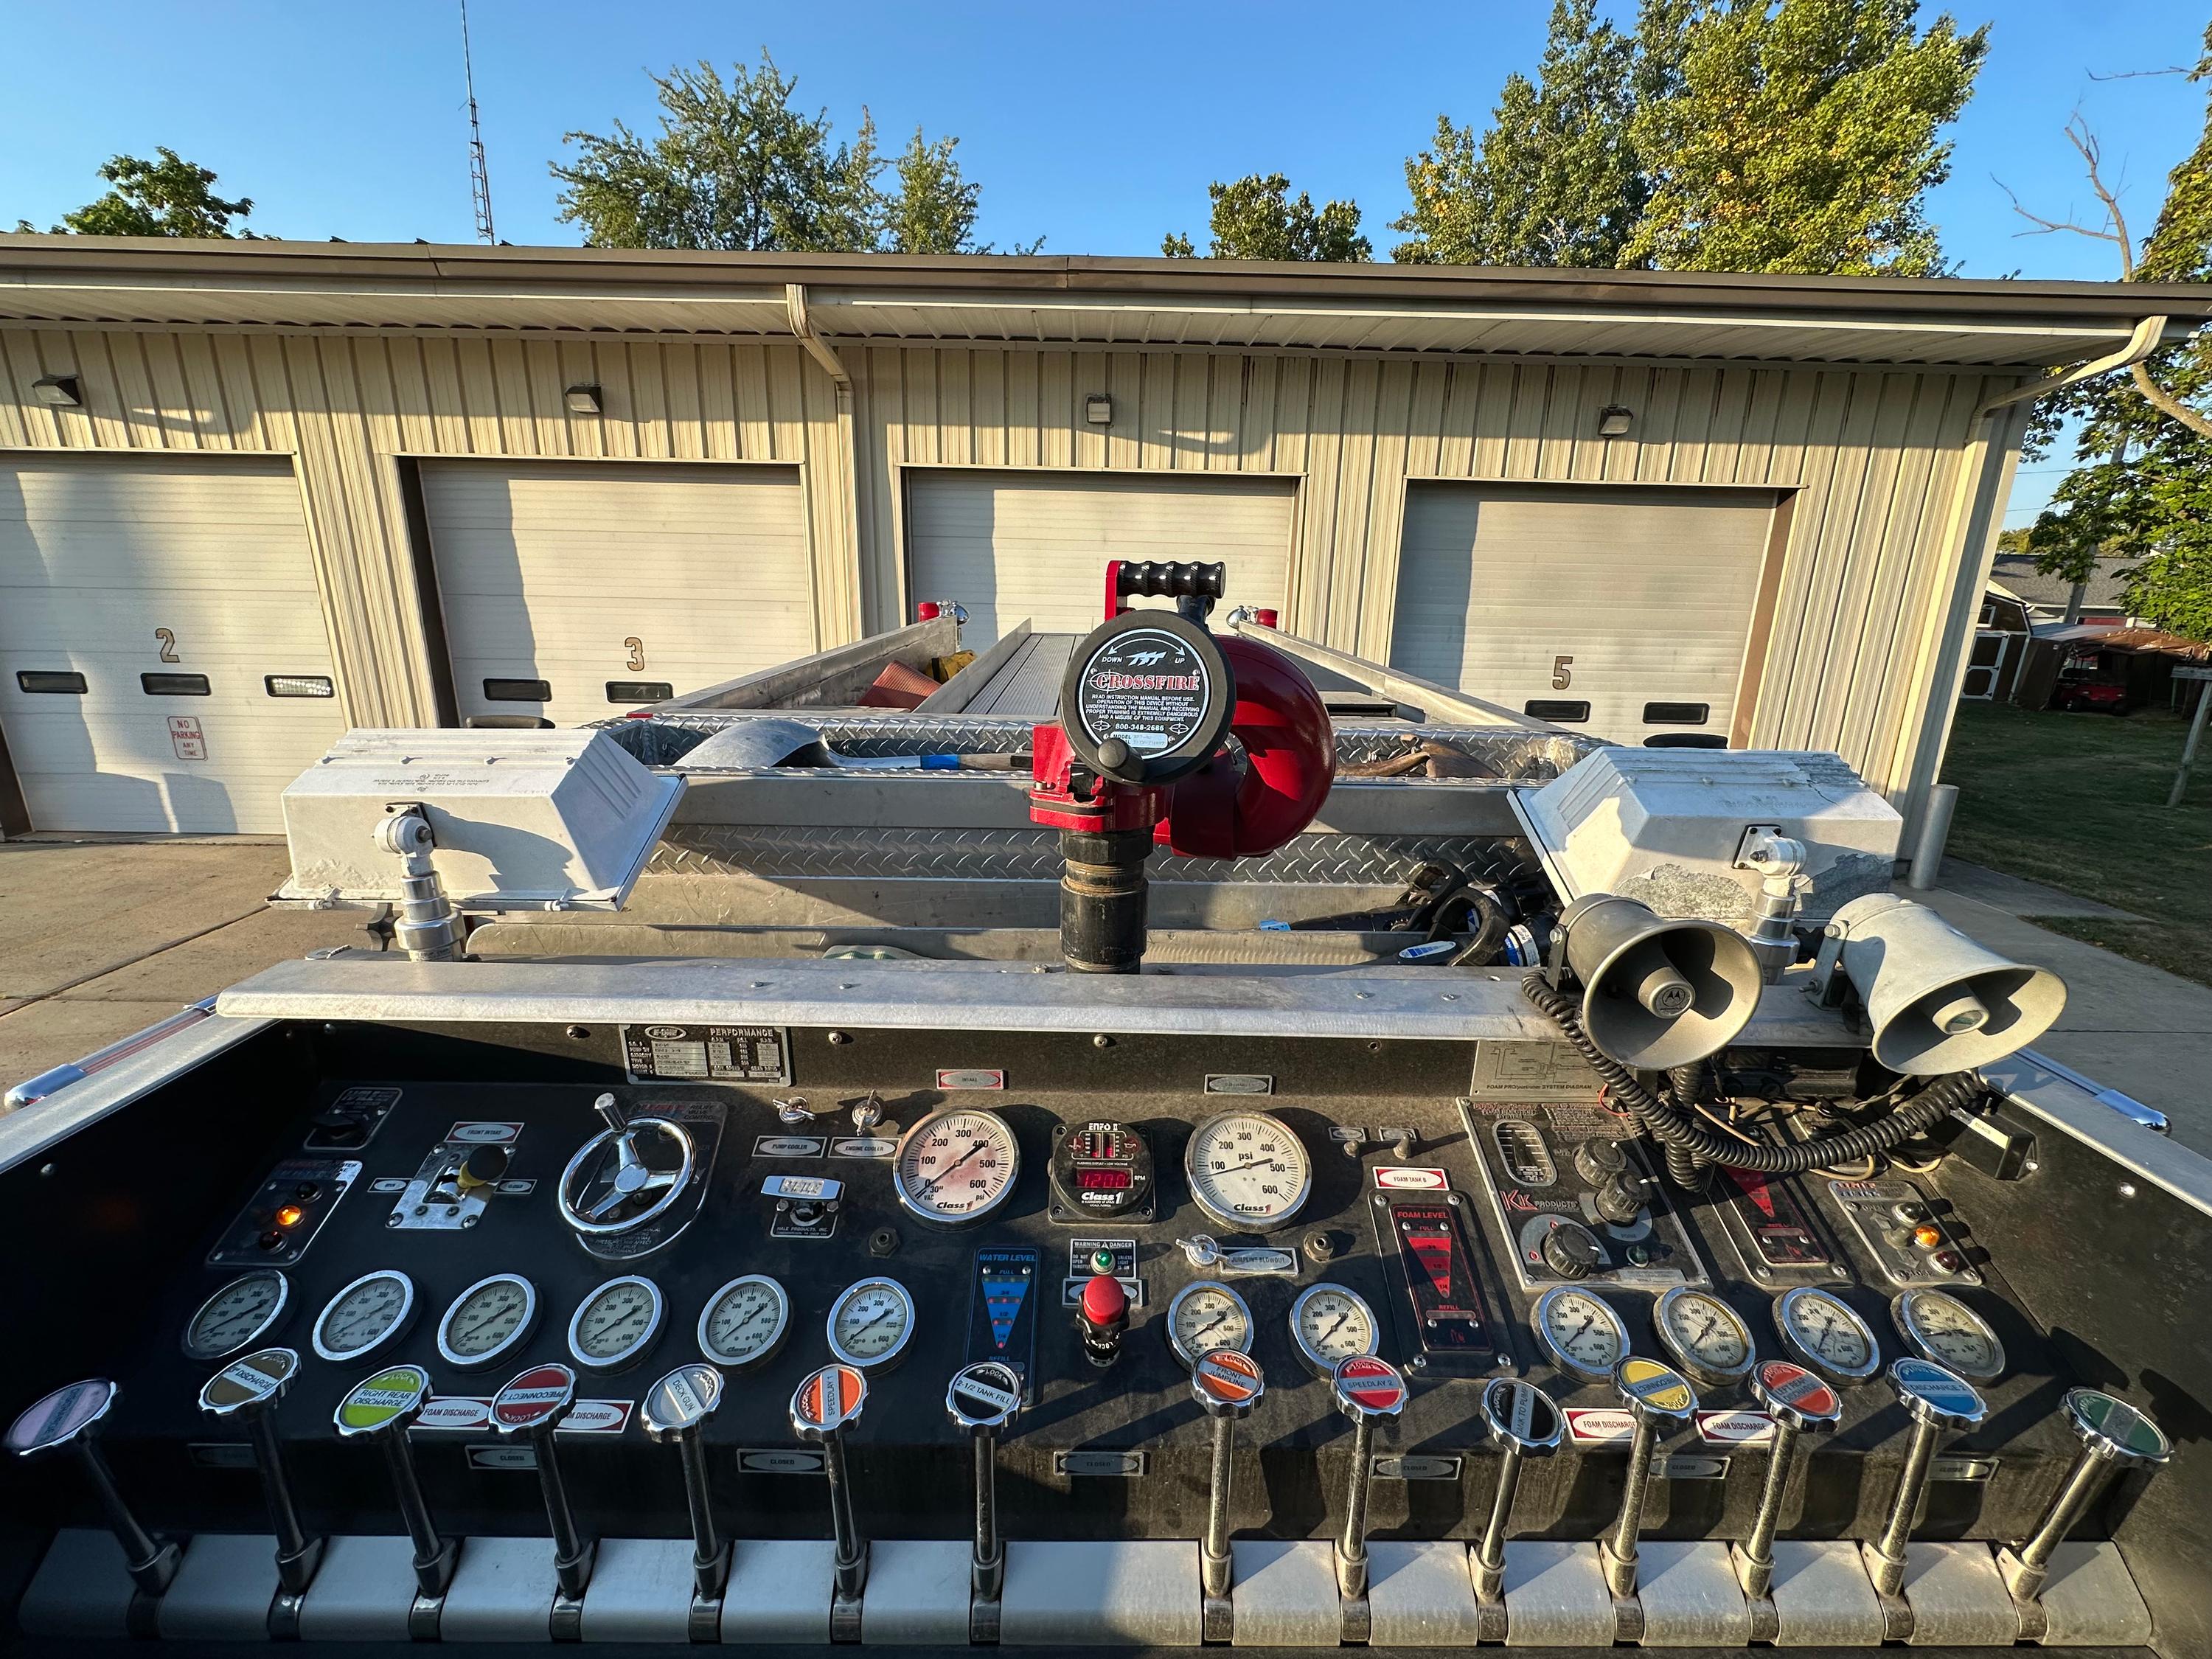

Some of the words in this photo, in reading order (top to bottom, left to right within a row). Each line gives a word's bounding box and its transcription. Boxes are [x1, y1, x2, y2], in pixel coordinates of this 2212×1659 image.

[156, 628, 180, 662] 2
[625, 637, 644, 671] 3
[1552, 656, 1573, 689] 5
[1096, 674, 1200, 691] CROSSFIRE
[177, 720, 189, 728] NO
[172, 731, 201, 739] PARKING
[710, 1028, 773, 1037] PERFORMANCE
[956, 1130, 971, 1138] 300
[1237, 1132, 1251, 1141] 300
[932, 1138, 948, 1147] 200
[973, 1140, 989, 1148] 400
[1219, 1141, 1234, 1150] 200
[1260, 1144, 1275, 1152] 400
[921, 1156, 936, 1164] 100
[1239, 1152, 1253, 1161] psi
[979, 1160, 995, 1168] 500
[1211, 1161, 1225, 1169] 100
[1270, 1164, 1285, 1172] 500
[925, 1179, 931, 1188] 0
[970, 1180, 987, 1189] 600
[1262, 1185, 1278, 1194] 600
[392, 1373, 410, 1381] LOCK
[985, 1369, 1003, 1380] LOCK
[1217, 1367, 1242, 1380] FRONT
[236, 1371, 273, 1388] DISCHARGE
[1207, 1371, 1246, 1388] JUMPLINE
[1637, 1376, 1680, 1392] PRECONNECT
[1776, 1386, 1792, 1396] LEFT
[1792, 1377, 1806, 1386] REAR
[361, 1390, 388, 1398] RIGHT
[389, 1391, 411, 1399] REAR
[507, 1391, 566, 1399] PRECONNECT
[672, 1380, 685, 1397] DECK
[683, 1397, 695, 1411] GUN
[957, 1380, 975, 1391] 2-1/2
[976, 1386, 995, 1399] TANK
[996, 1394, 1011, 1405] FILL
[354, 1398, 405, 1407] DISCHARGE
[1492, 1394, 1503, 1409] LOCK
[1519, 1408, 1526, 1416] TO
[509, 1413, 530, 1421] LOCK
[1516, 1419, 1524, 1437] TANK
[1731, 1422, 1767, 1430] DISCHARGE
